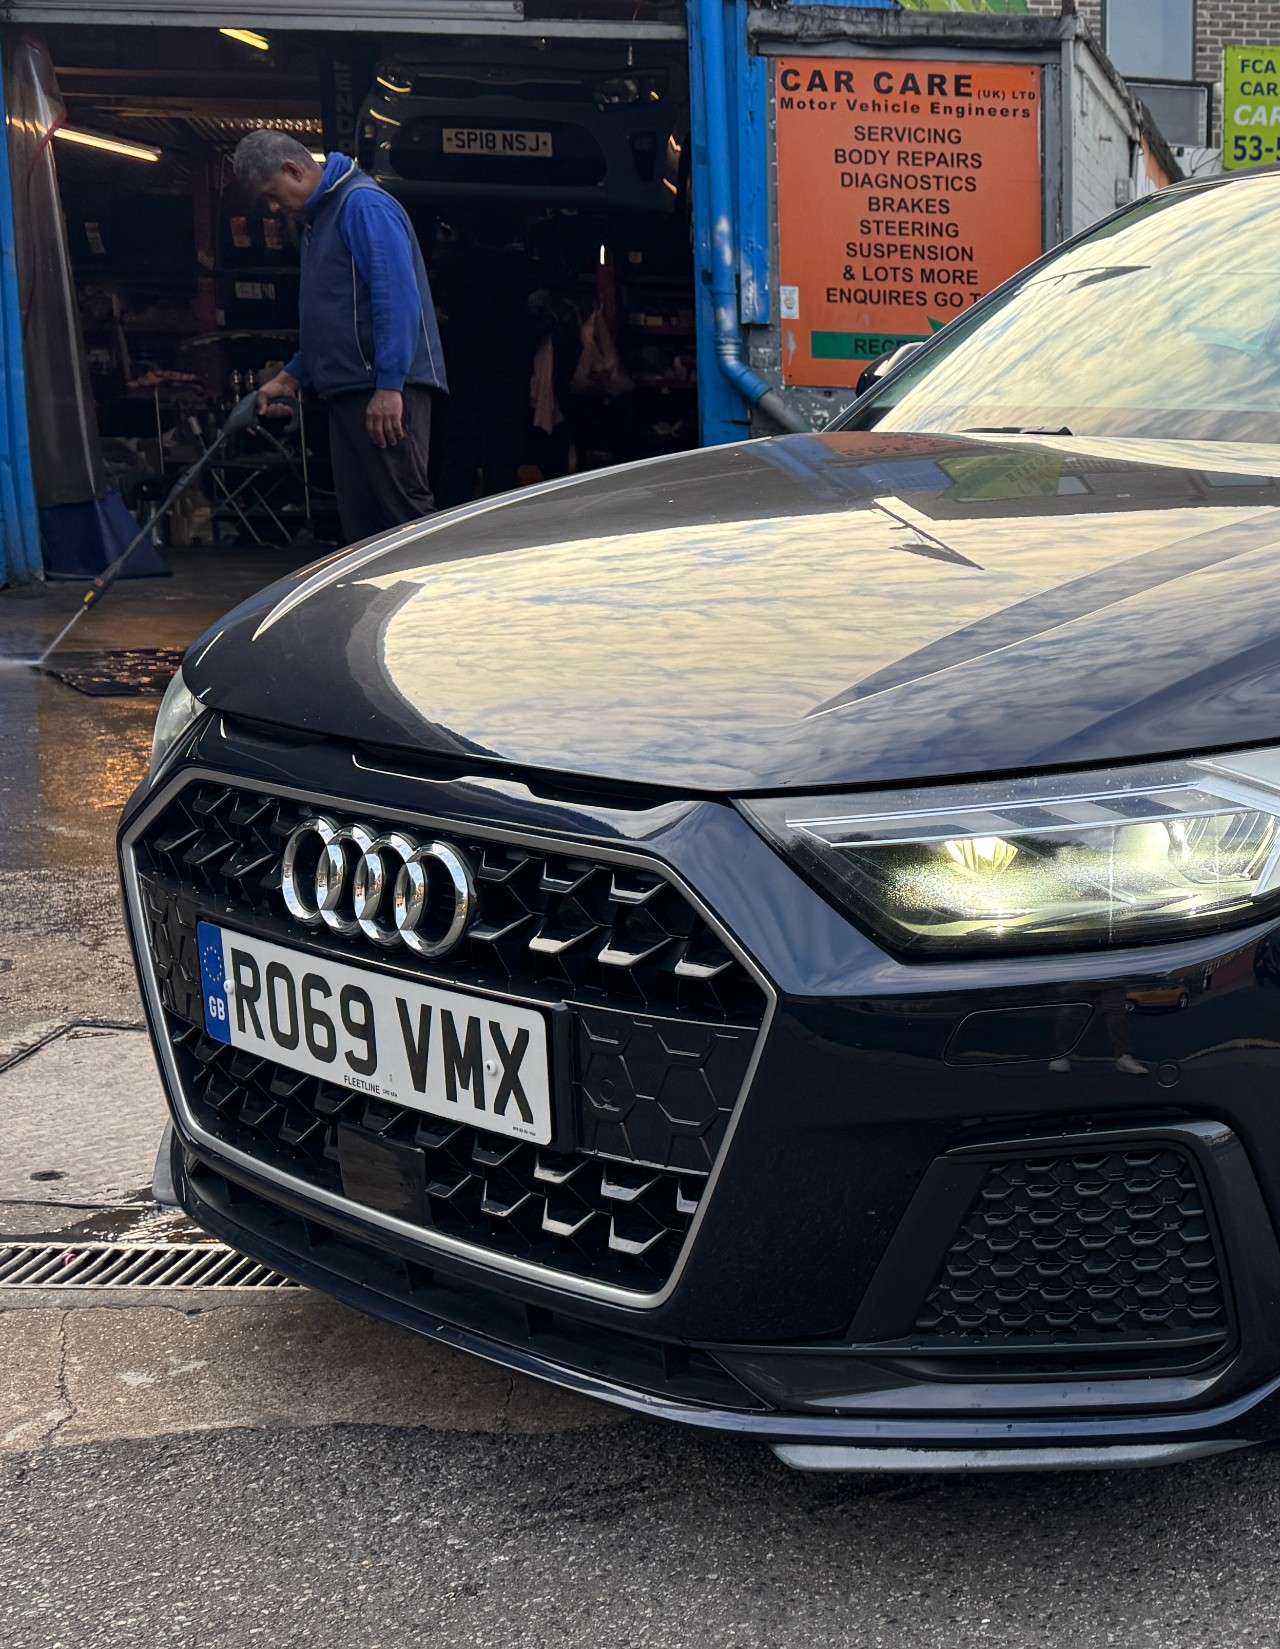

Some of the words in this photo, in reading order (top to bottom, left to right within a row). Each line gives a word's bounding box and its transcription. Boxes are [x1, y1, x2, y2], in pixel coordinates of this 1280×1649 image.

[1240, 59, 1277, 75] FCA
[781, 69, 855, 93] CAR
[873, 72, 973, 97] CARE
[977, 88, 1006, 101] (UK)
[1012, 90, 1036, 102] LTD
[1240, 81, 1278, 98] CAR
[780, 98, 836, 112] Motor
[847, 99, 921, 115] Vehicle
[930, 102, 1031, 119] Engineers
[455, 131, 496, 150] SP18
[502, 133, 540, 152] NSJ
[854, 125, 962, 145] SERVICING
[834, 149, 890, 166] BODY
[897, 150, 983, 169] REPAIRS
[840, 172, 977, 192] DIAGNOSTICS
[868, 196, 950, 215] BRAKES
[859, 219, 960, 238] STEERING
[846, 242, 974, 262] SUSPENSION
[842, 266, 856, 281] &
[862, 266, 914, 284] LOTS
[921, 268, 979, 285] MORE
[826, 288, 928, 307] ENQUIRES
[934, 291, 963, 308] GO
[208, 995, 226, 1021] GB
[395, 996, 534, 1125] VMX
[343, 1074, 381, 1096] FLEETLINE
